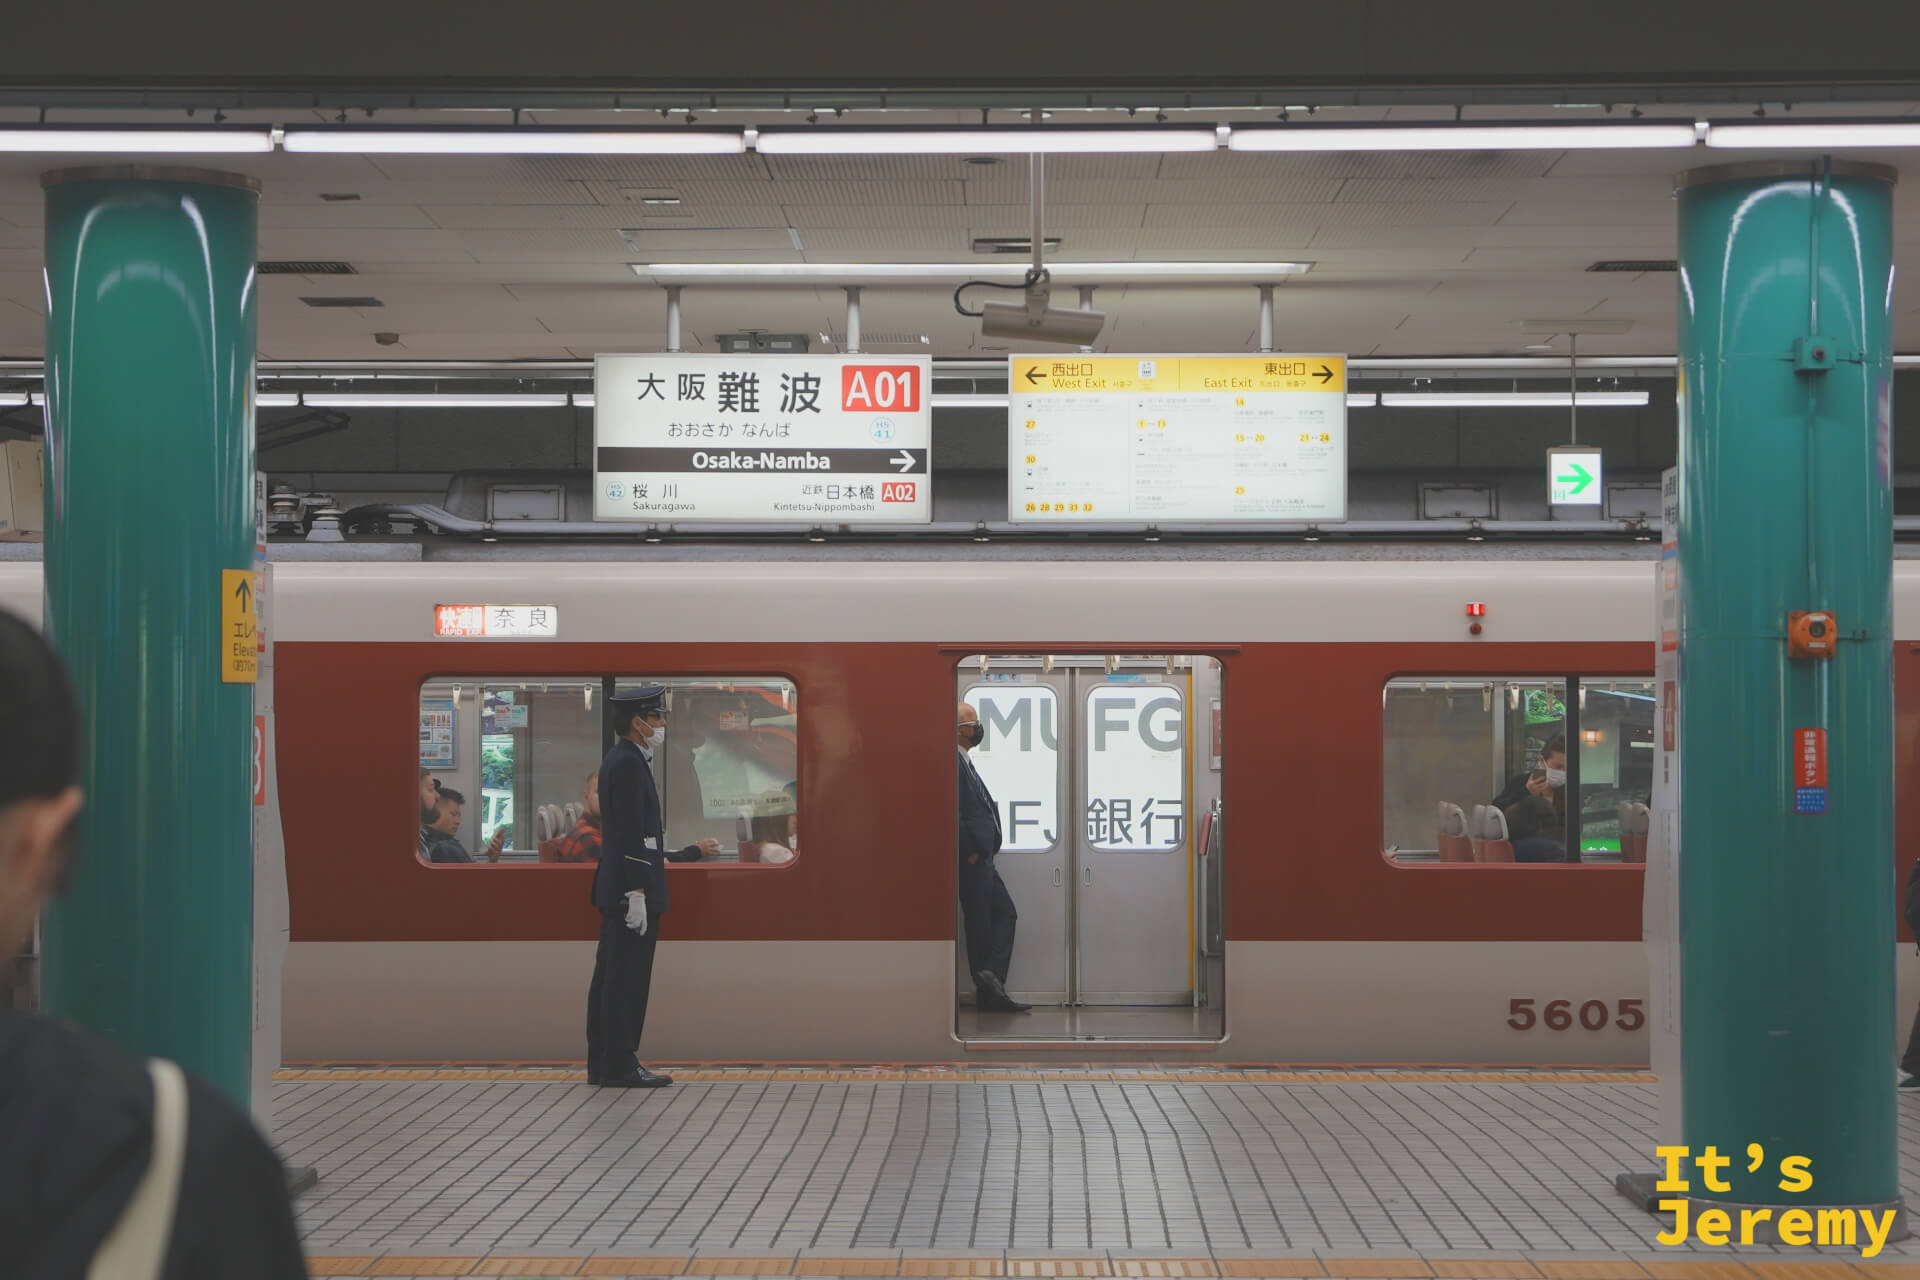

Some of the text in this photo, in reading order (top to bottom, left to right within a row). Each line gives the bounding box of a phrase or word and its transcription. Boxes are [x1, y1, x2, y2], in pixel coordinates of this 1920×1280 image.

[1052, 362, 1093, 377] 西出口
[1264, 362, 1306, 377] 東出口
[845, 370, 912, 408] A01
[1052, 377, 1107, 389] West Exit
[1204, 377, 1253, 388] East Exit
[637, 371, 822, 414] 大阪難波
[668, 422, 791, 438] おおさか なんば
[874, 430, 890, 439] 41
[692, 451, 831, 470] Osaka-Namba
[609, 490, 623, 498] 42
[632, 482, 679, 499] 桜川
[882, 484, 914, 501] A02
[633, 501, 696, 512] Sakuragawa
[773, 503, 875, 513] Kintetsu-Nippombashi
[494, 607, 548, 629] 奈良
[1507, 998, 1646, 1032] 5605
